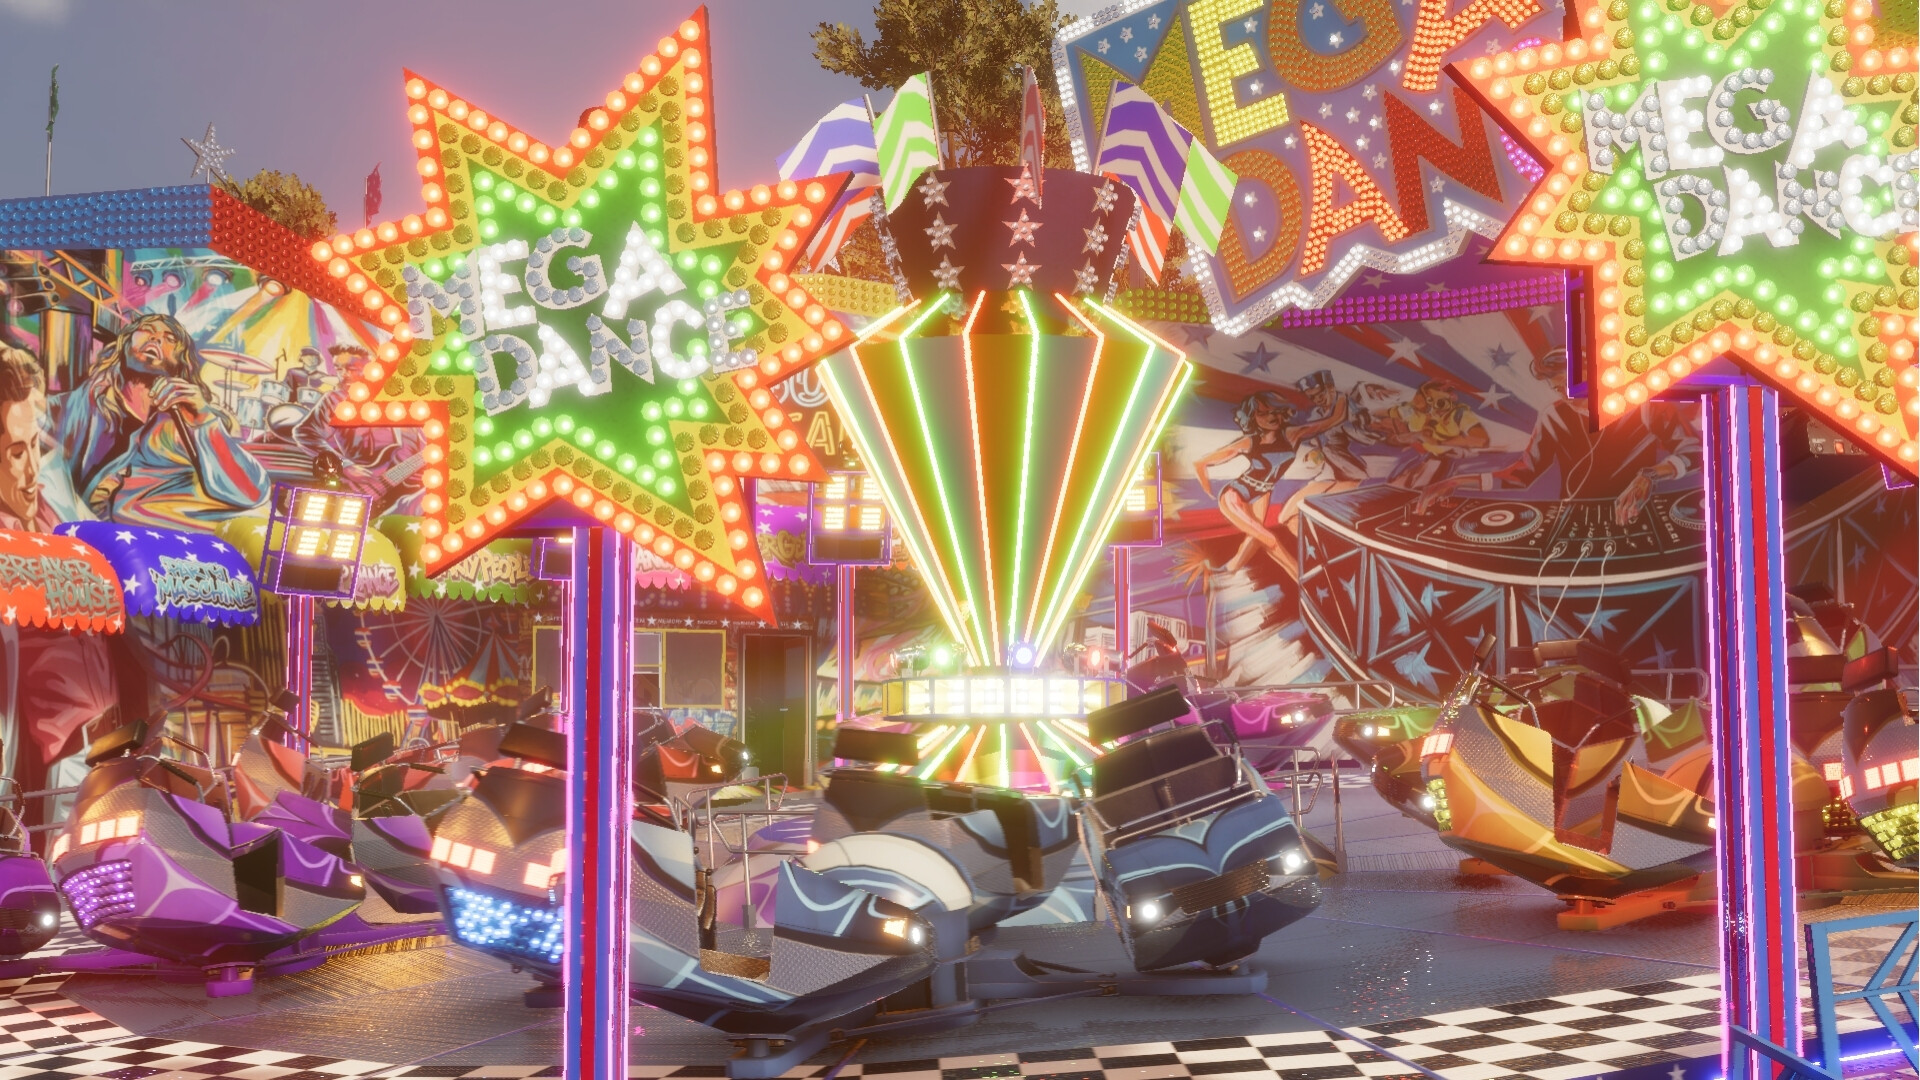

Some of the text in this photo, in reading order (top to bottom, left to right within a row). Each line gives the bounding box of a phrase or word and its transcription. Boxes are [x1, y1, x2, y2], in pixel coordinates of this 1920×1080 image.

[1579, 67, 1868, 181] MEGA
[1216, 86, 1545, 304] DAN
[403, 220, 687, 342] MEGA
[471, 288, 758, 416] DANCE
[45, 578, 121, 617] HOUSE
[150, 569, 257, 611] MASCHINE
[160, 556, 229, 583] PARTY
[477, 548, 534, 587] PEOPL
